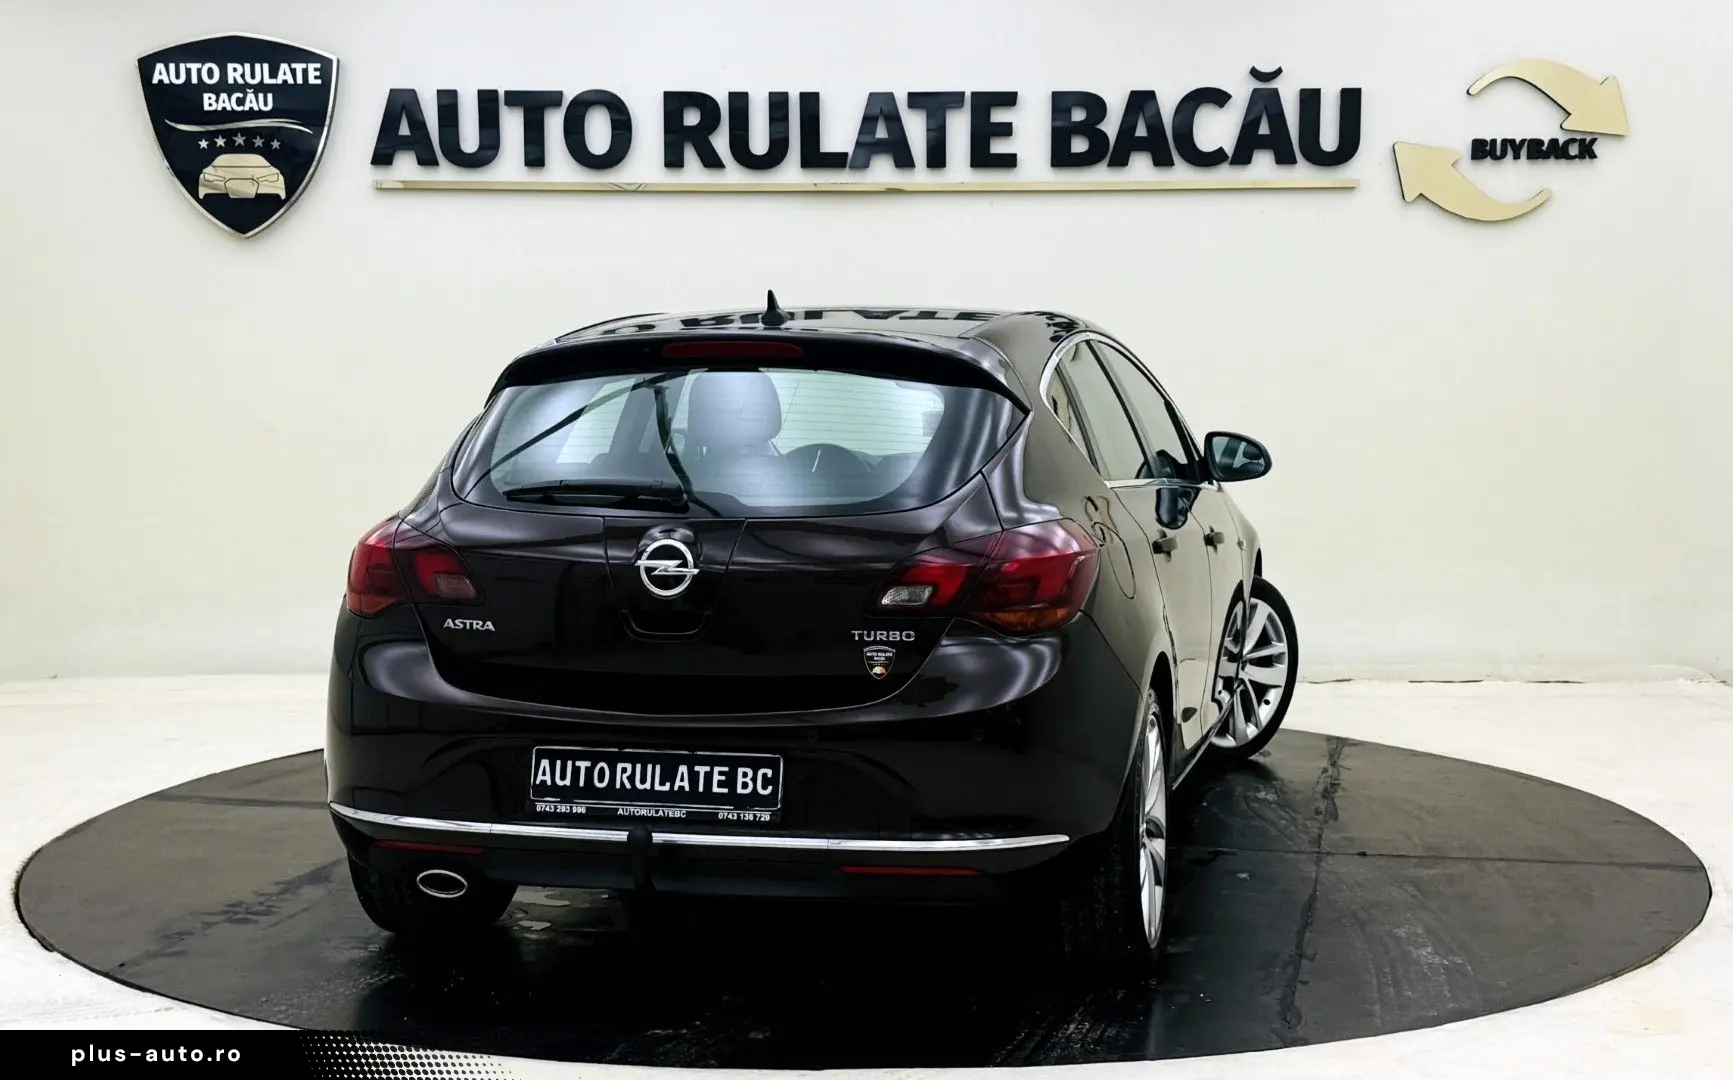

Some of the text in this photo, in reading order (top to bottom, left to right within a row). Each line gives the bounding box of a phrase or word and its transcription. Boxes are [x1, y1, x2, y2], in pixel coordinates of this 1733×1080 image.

[152, 62, 322, 85] AUTO RULATE
[202, 88, 274, 112] BACĂU
[370, 65, 1362, 170] AUTO RULATE BACĂU
[1471, 137, 1598, 161] BUYBACK
[443, 618, 496, 632] ASTRA
[850, 630, 916, 641] TURBO
[736, 767, 773, 795] BC
[536, 804, 555, 812] 0743
[617, 808, 687, 818] AUTORULATEBC
[718, 812, 738, 820] 0743
